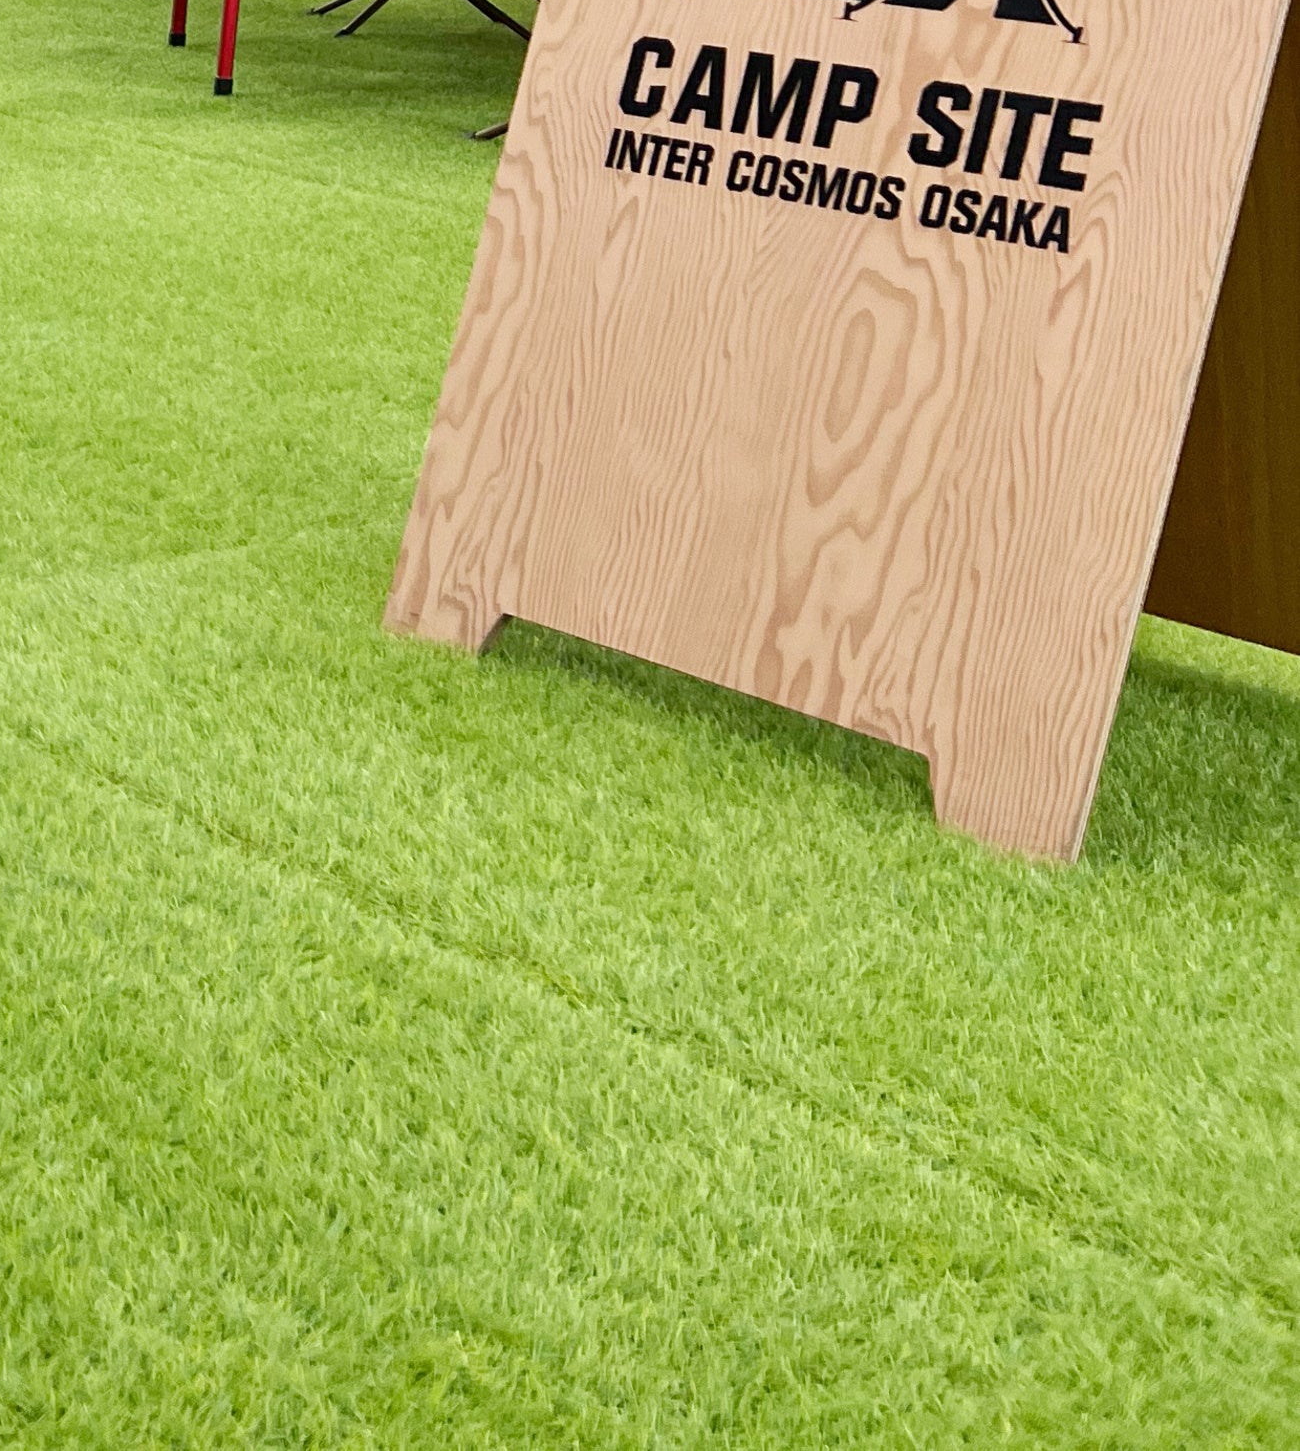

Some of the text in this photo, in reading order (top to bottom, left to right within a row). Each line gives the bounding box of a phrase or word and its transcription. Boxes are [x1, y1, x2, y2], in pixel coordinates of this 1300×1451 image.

[618, 35, 1104, 192] CAMP SITE
[604, 128, 1072, 254] INTER COSMOS OSAKA
